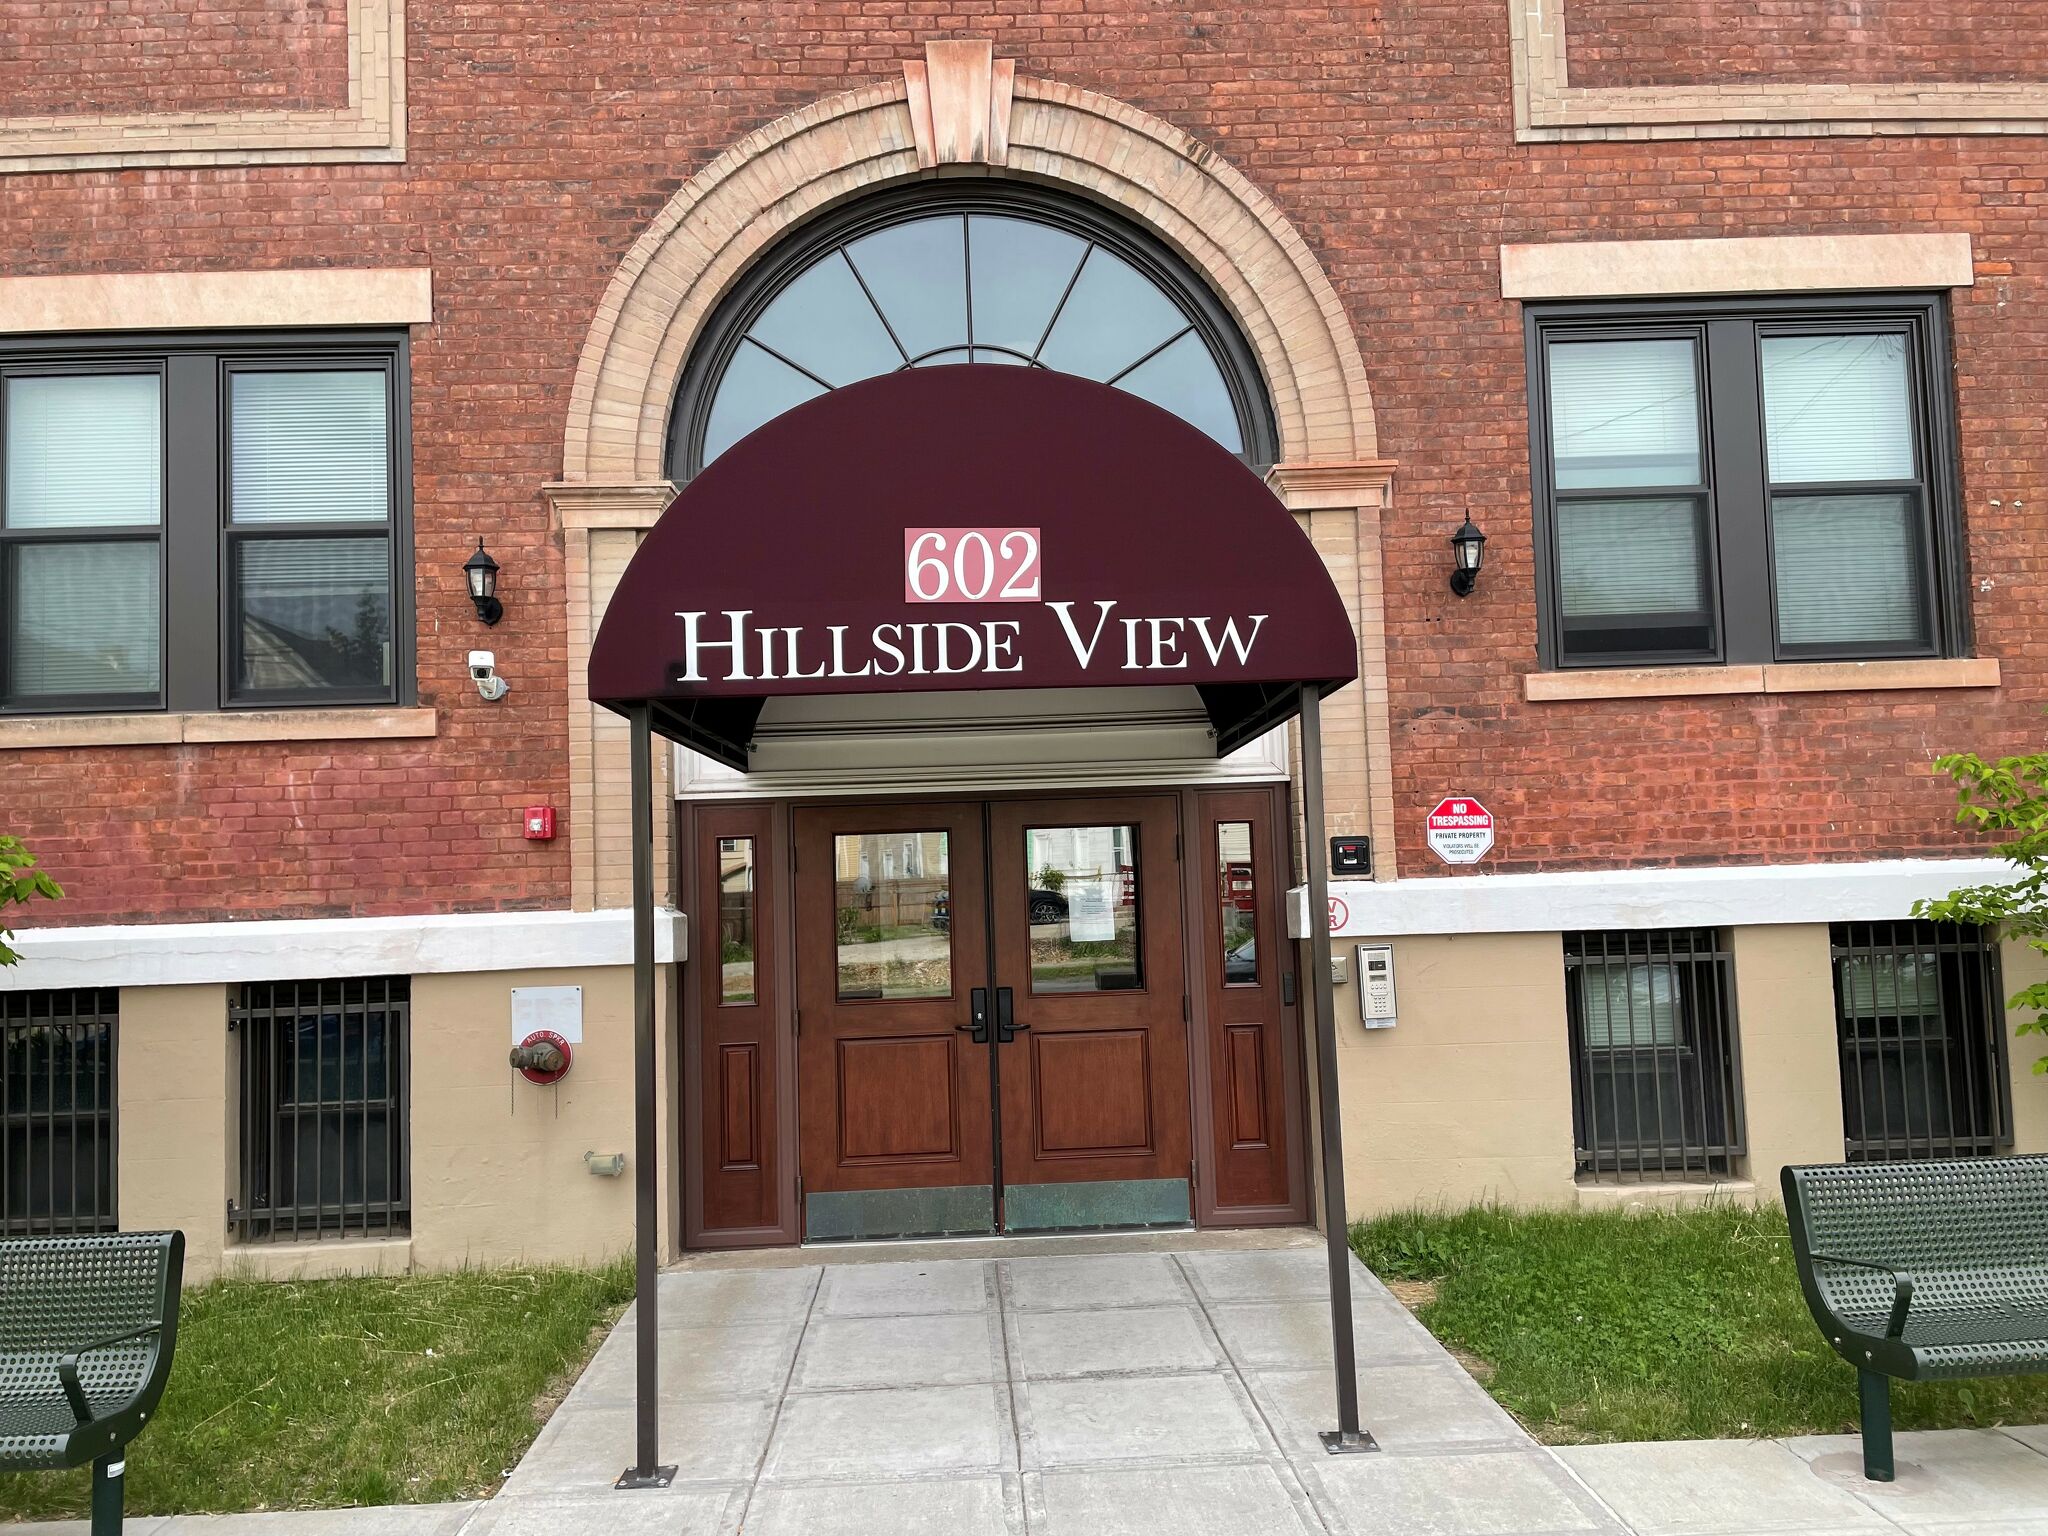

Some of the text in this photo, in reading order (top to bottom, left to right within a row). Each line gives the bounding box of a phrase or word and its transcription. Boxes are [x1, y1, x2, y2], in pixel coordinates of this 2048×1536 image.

[908, 531, 1039, 600] 602
[674, 600, 1269, 682] HILLSIDE VIEW
[1452, 803, 1467, 814] NO
[1432, 815, 1489, 826] TRESPASSING
[1328, 914, 1337, 926] R
